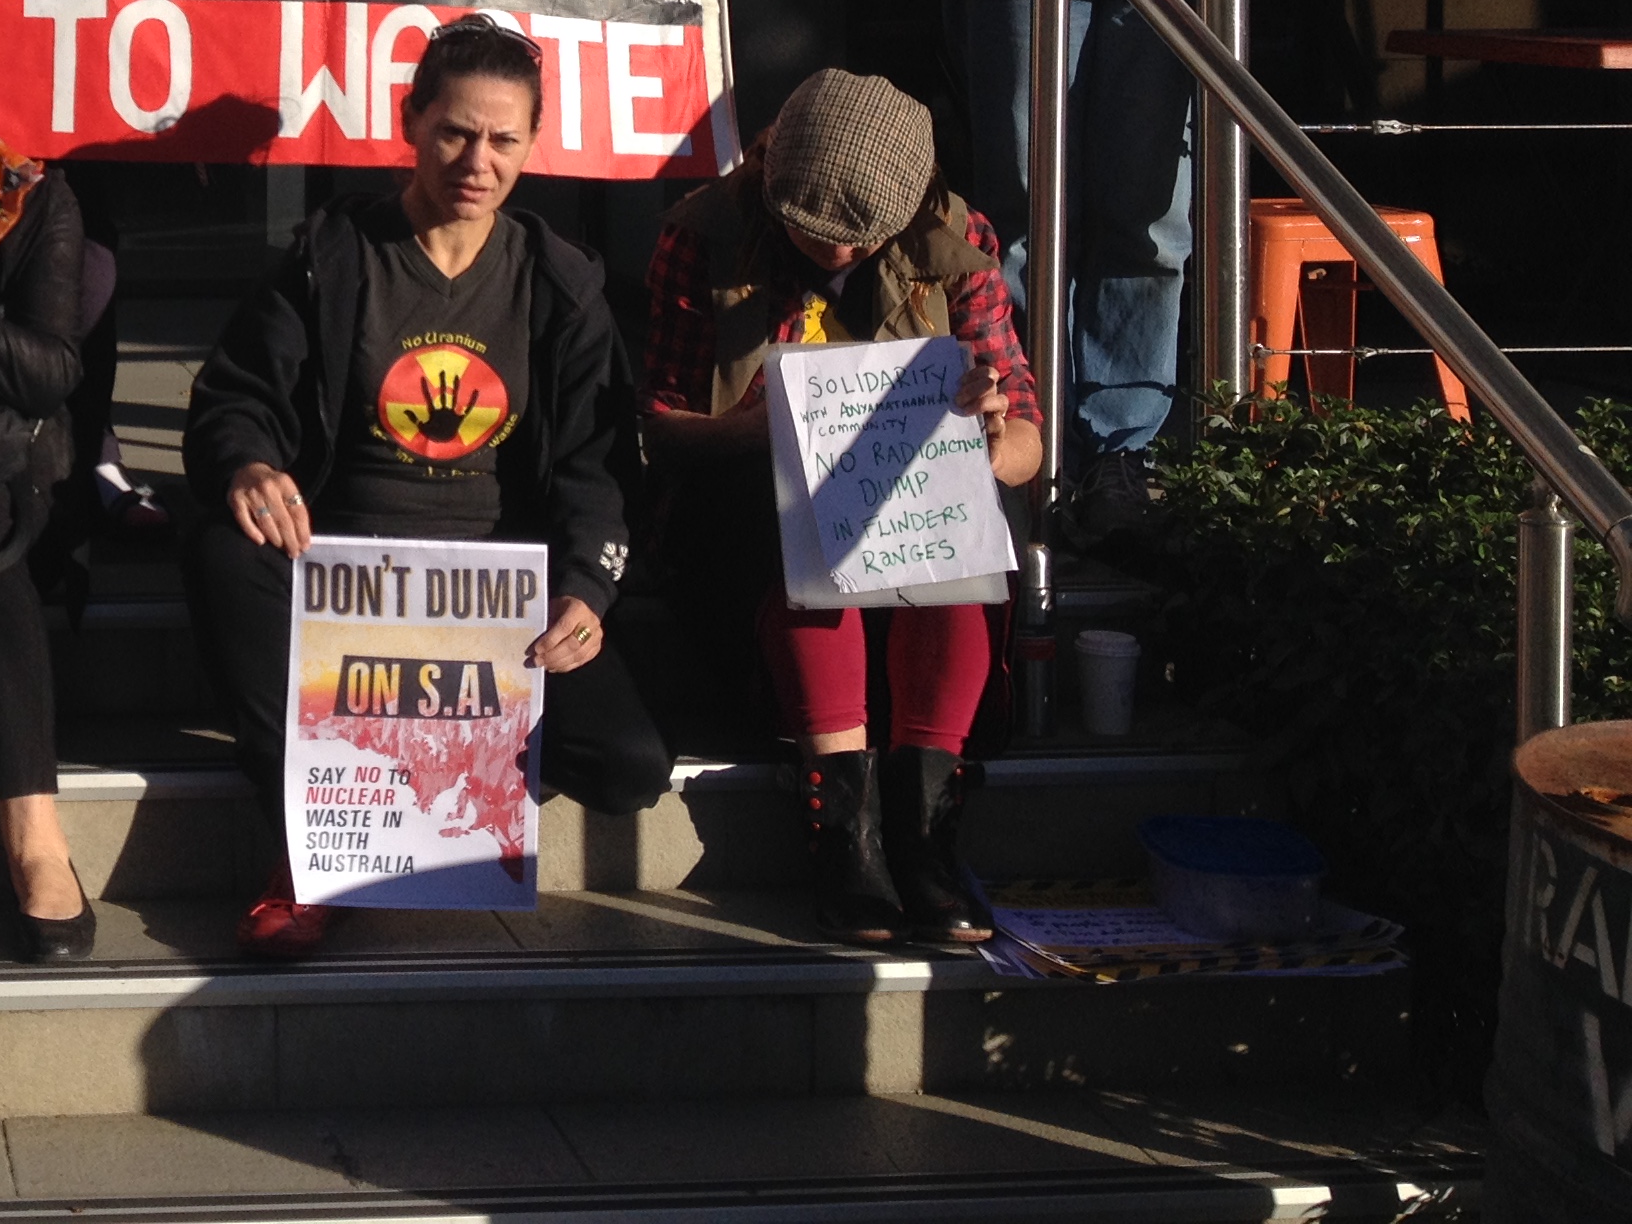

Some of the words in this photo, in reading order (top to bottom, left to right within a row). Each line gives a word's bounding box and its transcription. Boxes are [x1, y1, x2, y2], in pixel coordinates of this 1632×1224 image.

[279, 0, 694, 157] WATE
[401, 335, 422, 350] No
[425, 331, 487, 354] Uranium
[808, 364, 948, 399] SOLIDARITY
[800, 406, 828, 423] WITH
[815, 451, 857, 480] NO
[872, 437, 985, 466] RADIOACTIVE
[858, 471, 929, 507] DUMP
[832, 518, 854, 541] IN
[862, 503, 968, 539] FLINDERS
[304, 554, 411, 618] DON'T
[425, 568, 539, 619] DUMP
[346, 662, 400, 715] ON
[418, 663, 495, 717] S.A.
[307, 767, 347, 786] SAY
[354, 766, 381, 784] NO
[388, 768, 411, 786] TO
[306, 787, 395, 806] NUCLEAR
[306, 809, 372, 828] WASTE
[383, 810, 403, 829] IN
[306, 831, 369, 850] SOUTH
[308, 853, 415, 874] AUSTRALIA
